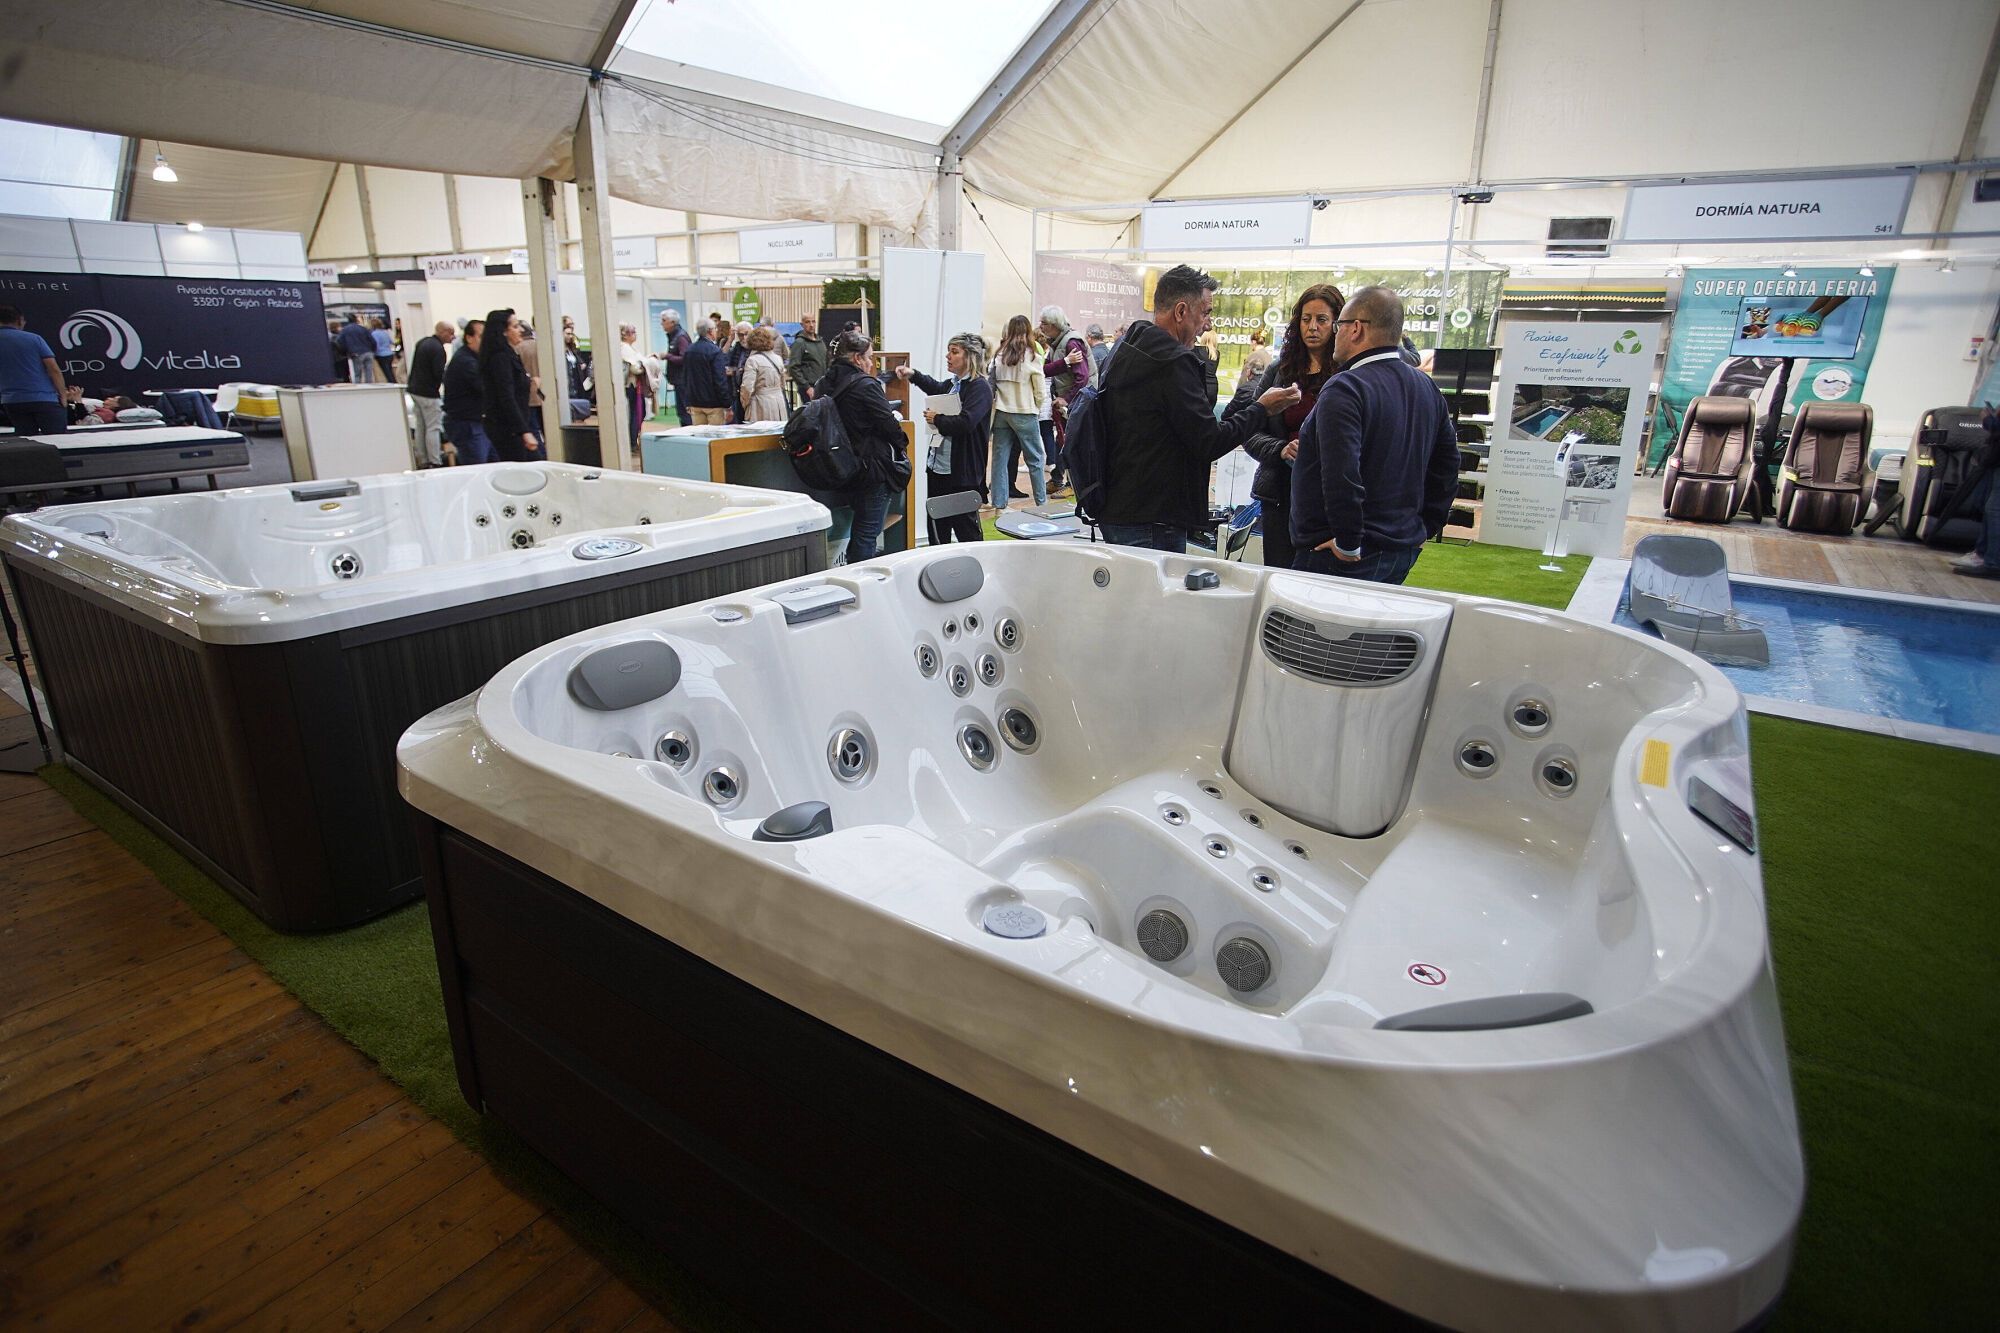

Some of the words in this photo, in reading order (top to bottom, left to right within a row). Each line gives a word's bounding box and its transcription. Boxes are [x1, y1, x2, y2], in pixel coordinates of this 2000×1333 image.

[1695, 203, 1754, 217] DORMÍA
[1757, 202, 1821, 215] NATURA
[1184, 221, 1220, 230] DORMÍA
[1222, 220, 1260, 229] NATURA
[1874, 225, 1893, 233] 541
[784, 239, 804, 247] SOLAR
[176, 285, 219, 295] Avenida
[220, 286, 276, 297] Constitución
[278, 288, 290, 298] 76
[1076, 280, 1106, 293] HOTELES
[1118, 284, 1140, 296] MUNDO
[1694, 280, 1746, 296] SUPER
[1753, 280, 1817, 296] OFERTA
[1824, 280, 1877, 296] FERIA
[192, 297, 225, 307] 33207
[233, 298, 260, 309] Gijón
[267, 299, 304, 309] Asturias
[1523, 331, 1569, 342] Piscines
[142, 349, 242, 370] vitalia
[1540, 348, 1610, 368] Ecofriendly
